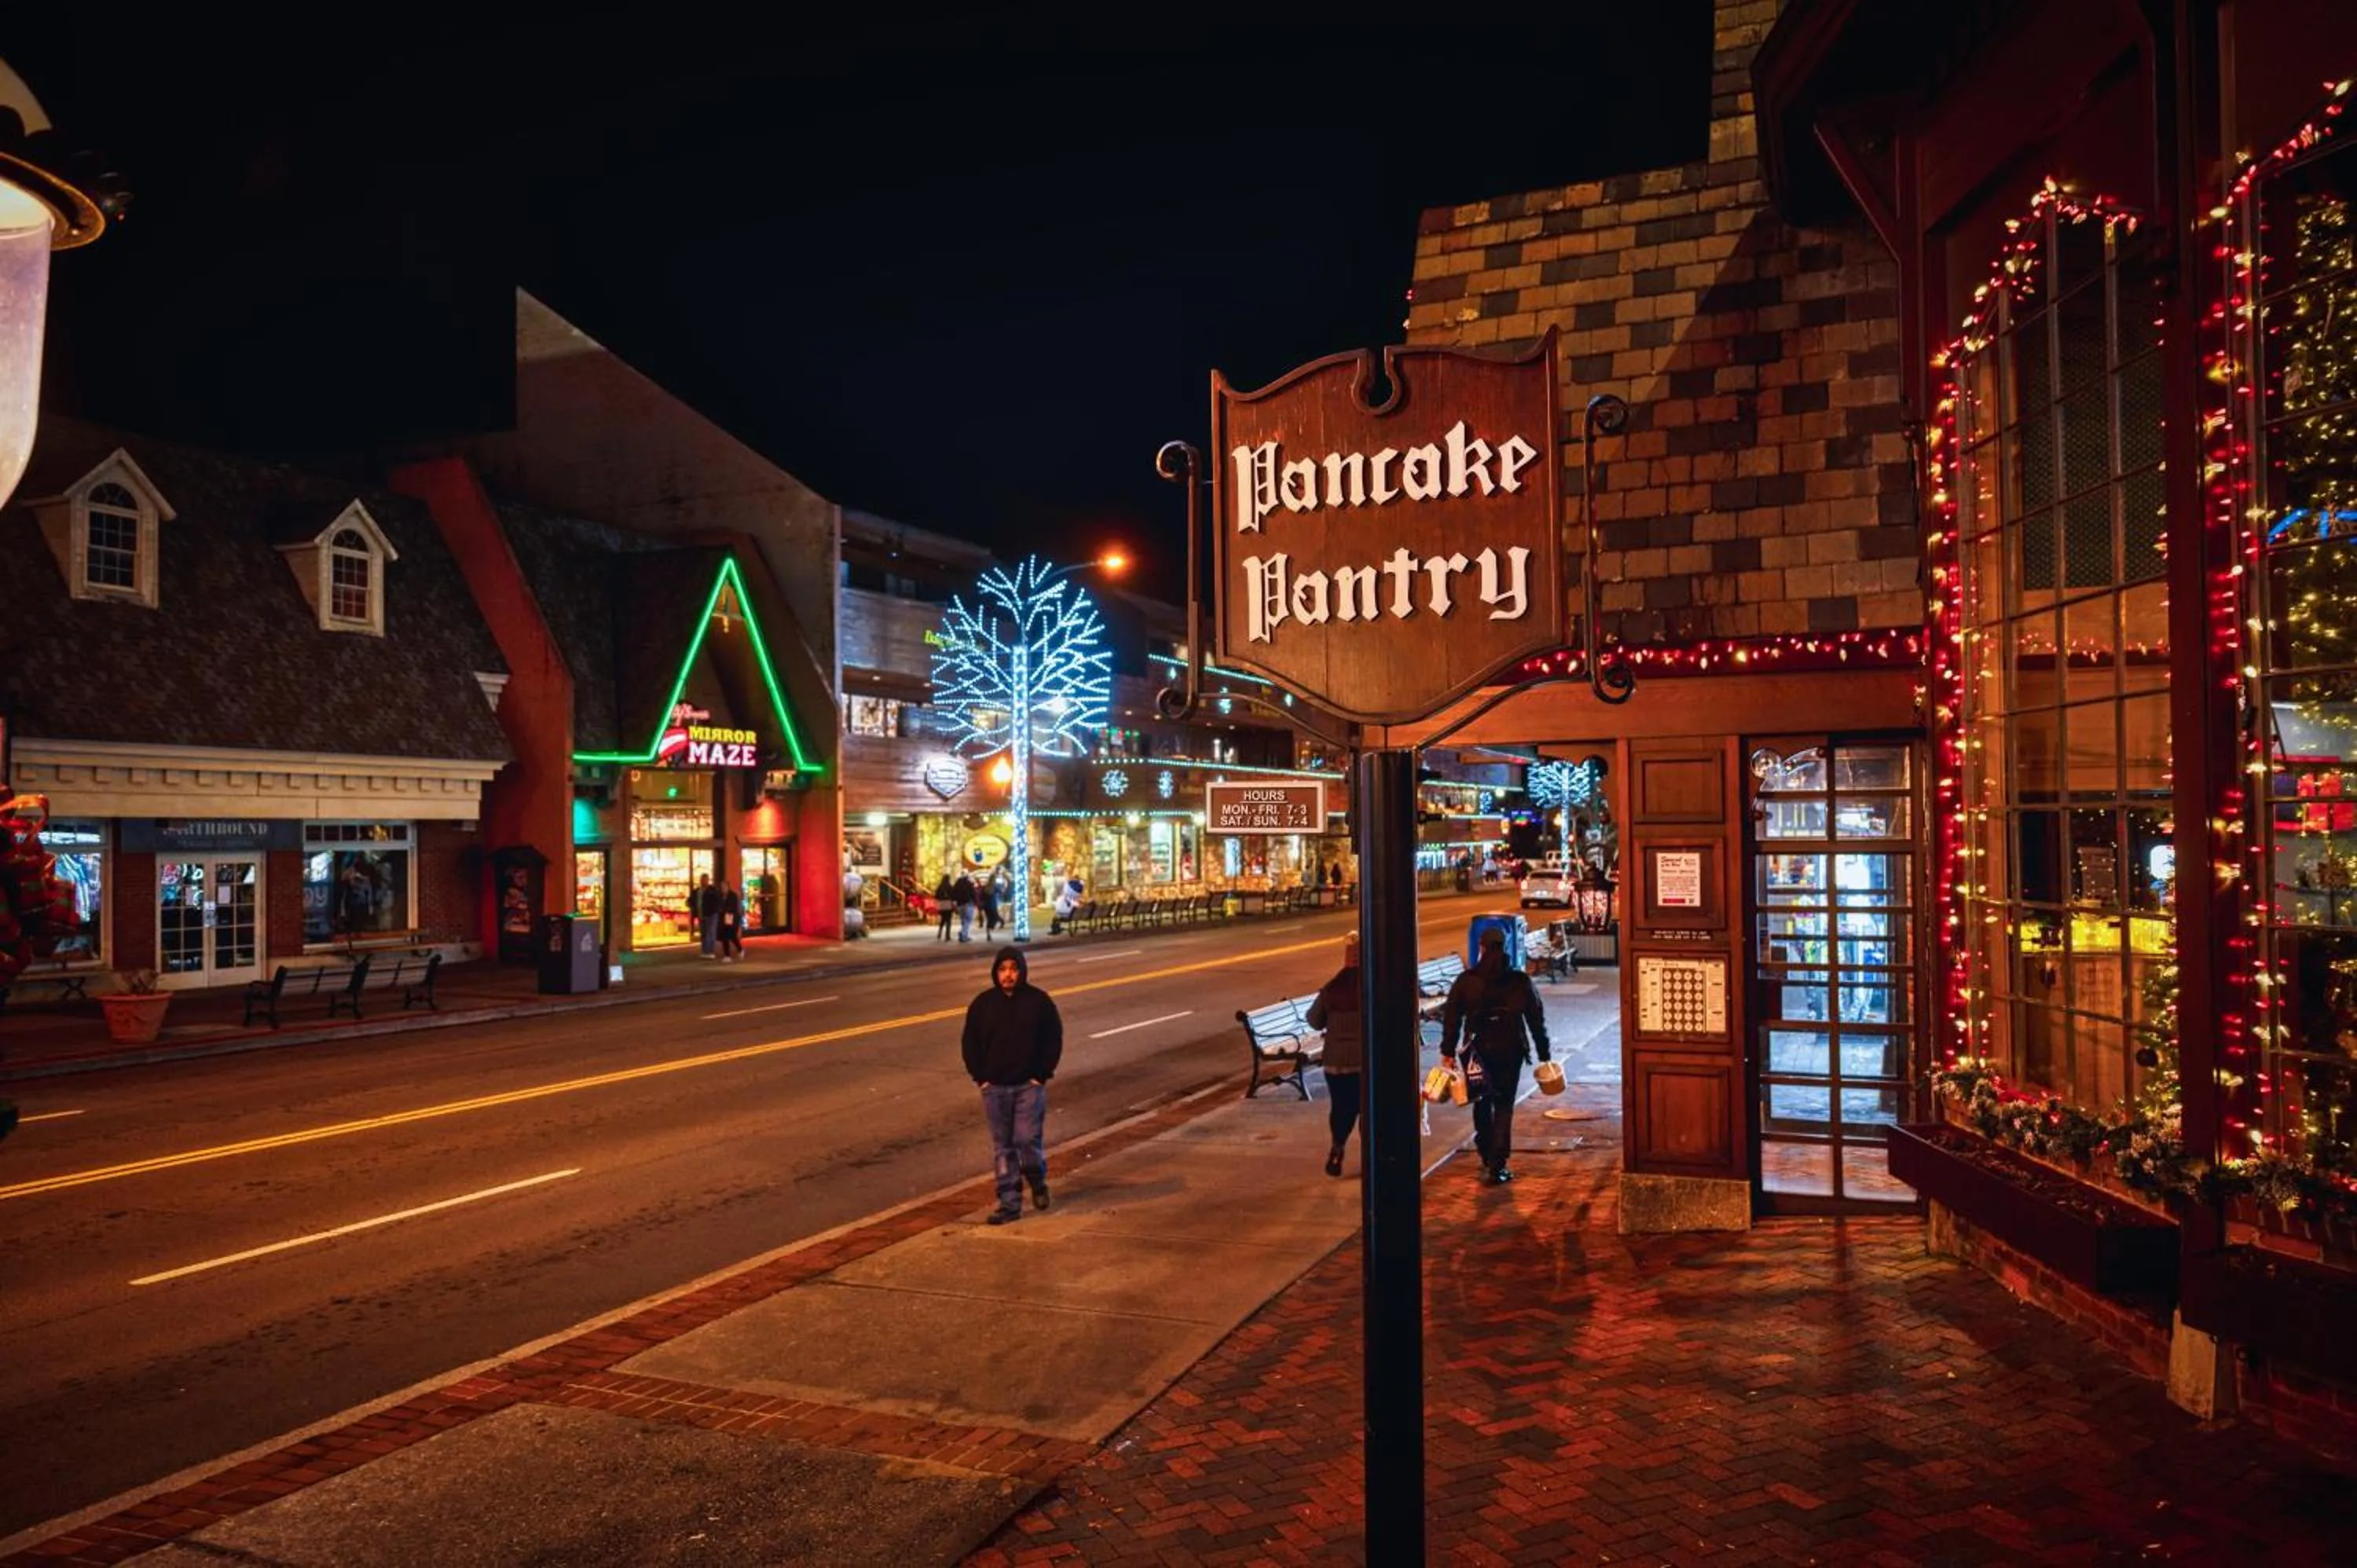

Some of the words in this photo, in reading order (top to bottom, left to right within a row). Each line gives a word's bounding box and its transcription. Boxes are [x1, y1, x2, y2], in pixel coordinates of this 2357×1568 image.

[1232, 420, 1538, 533] Pancake
[1242, 546, 1530, 643] Pantry
[688, 741, 757, 766] MAZE
[1244, 789, 1285, 800] HOURS
[1258, 804, 1280, 815] FRI.
[1220, 815, 1244, 826] SAT.
[1253, 815, 1281, 826] SUN.
